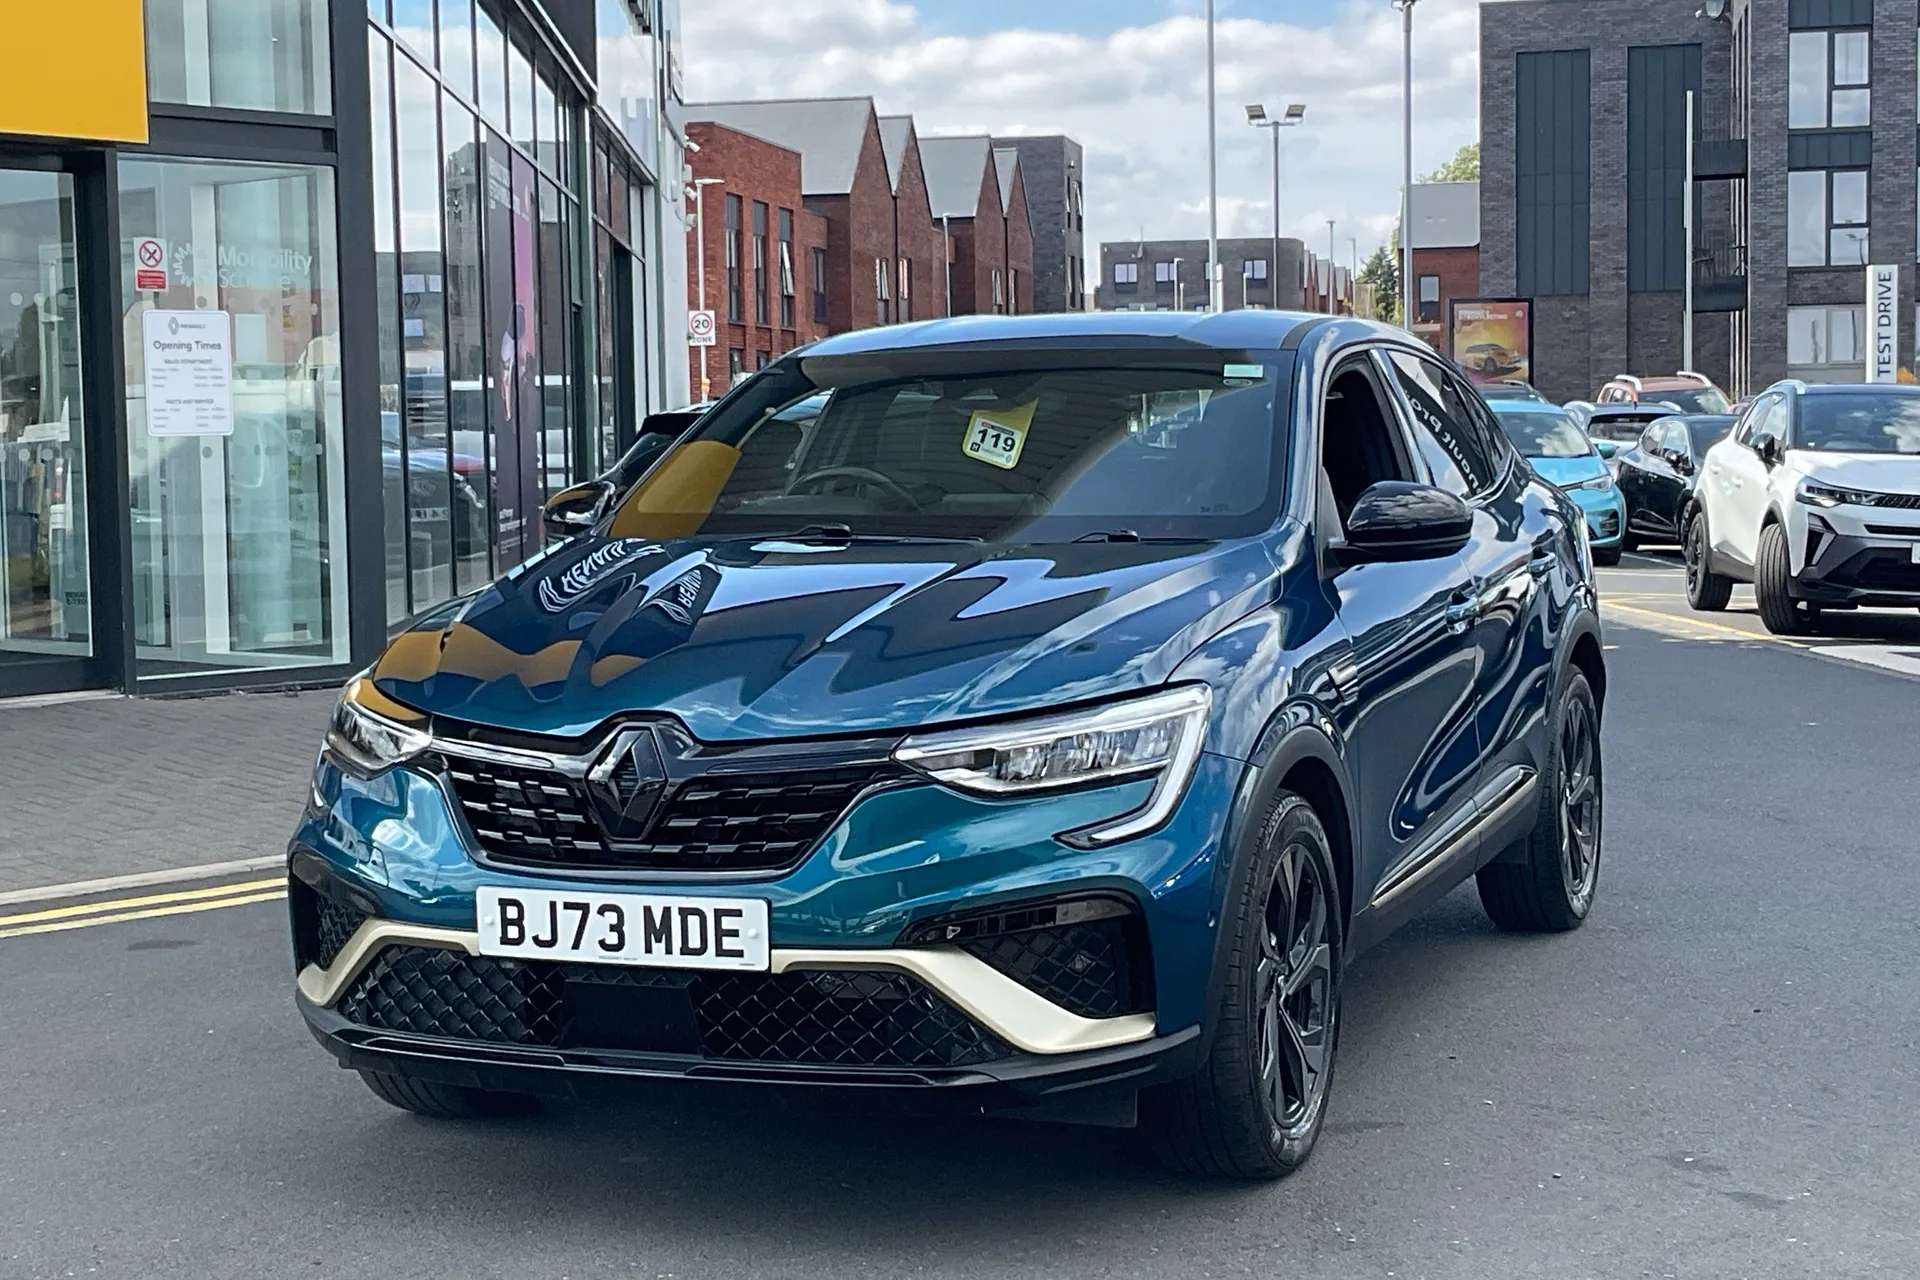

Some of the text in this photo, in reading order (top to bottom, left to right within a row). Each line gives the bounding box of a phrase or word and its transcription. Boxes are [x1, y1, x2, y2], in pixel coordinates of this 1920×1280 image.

[694, 319, 710, 329] 20
[1878, 271, 1892, 377] TEST DRIVE
[153, 340, 222, 352] Opening Times
[977, 428, 1016, 452] 119
[497, 897, 744, 958] BJ73 MDE
